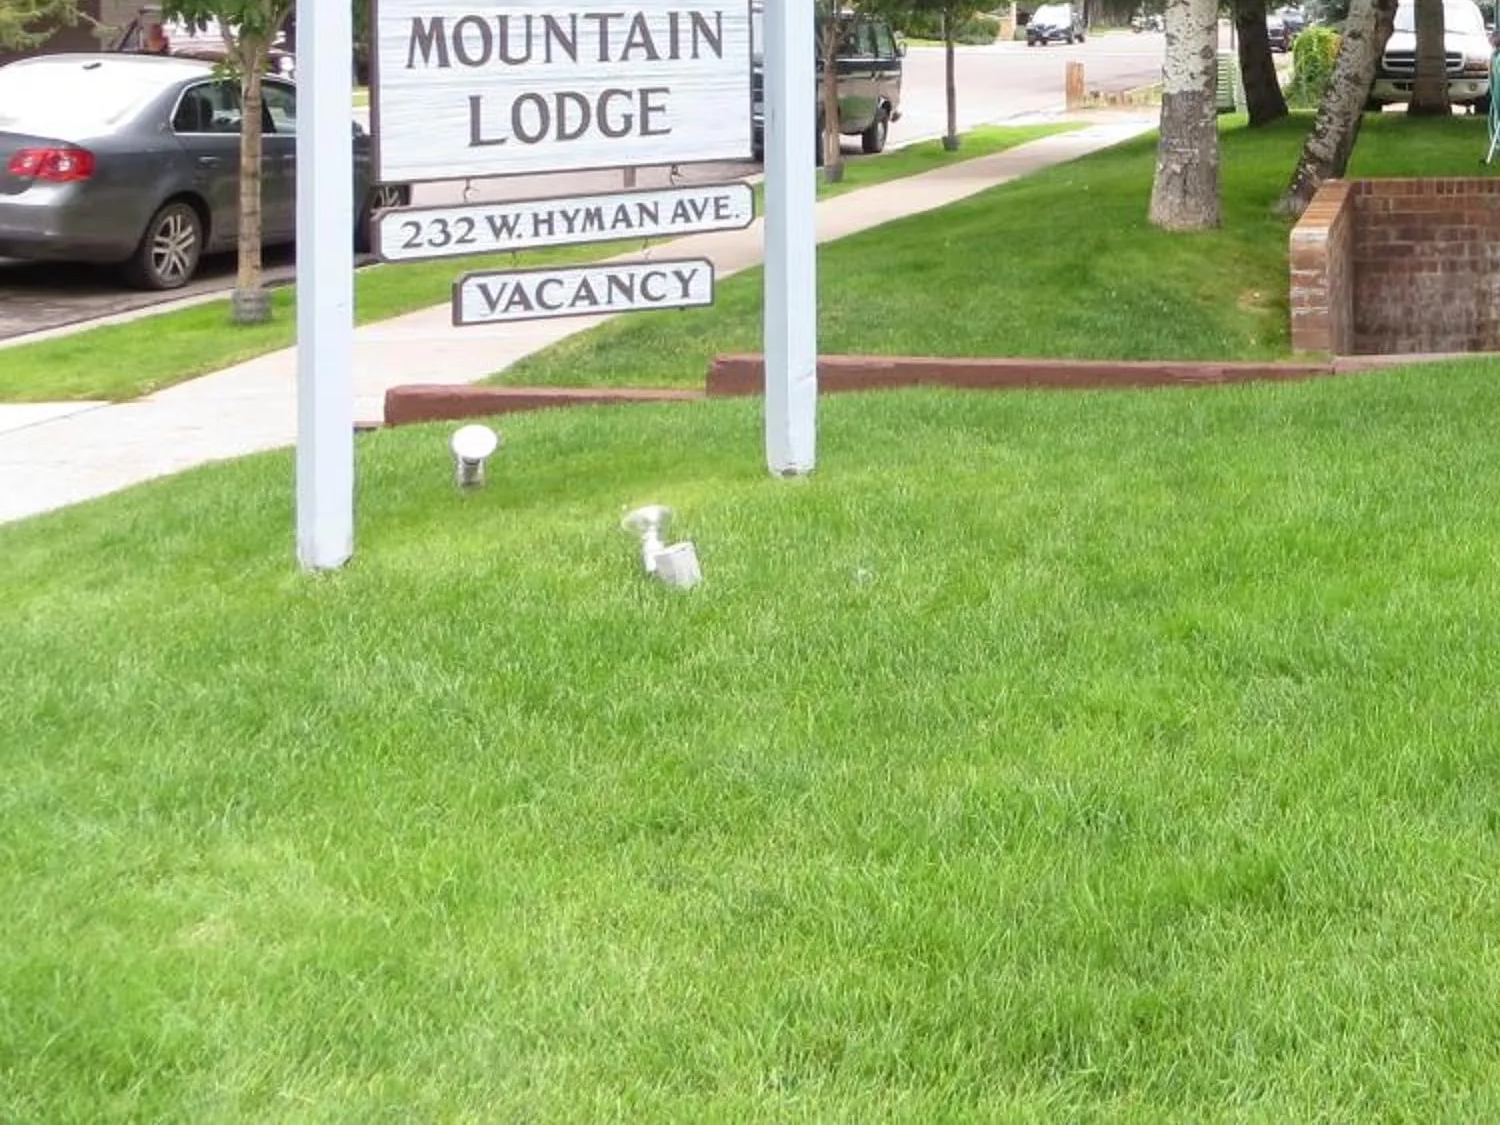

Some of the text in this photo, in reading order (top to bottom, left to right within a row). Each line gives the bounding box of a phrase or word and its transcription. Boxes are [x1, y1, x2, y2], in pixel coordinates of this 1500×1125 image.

[406, 11, 723, 69] MOUNTAIN
[468, 88, 672, 147] LODGE
[402, 195, 741, 249] 232 W. HYMAN AVE.
[477, 268, 699, 313] VACANCY
